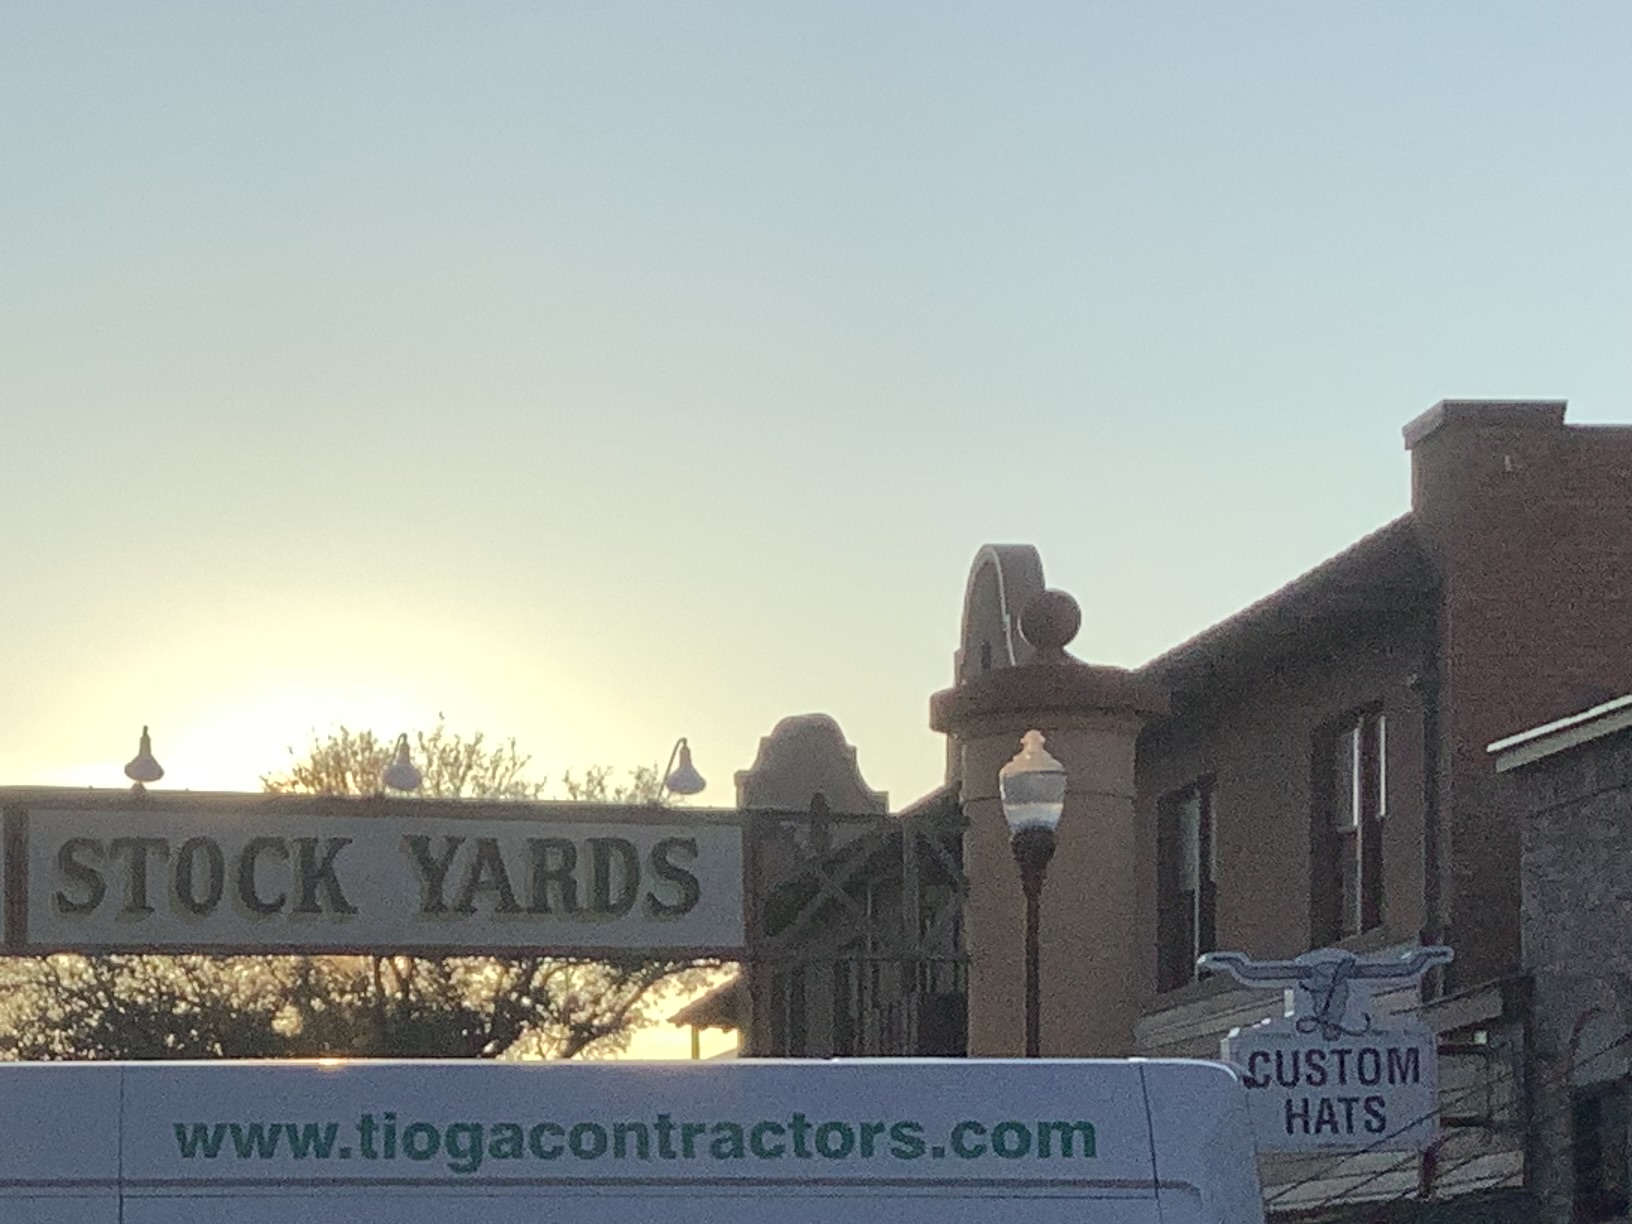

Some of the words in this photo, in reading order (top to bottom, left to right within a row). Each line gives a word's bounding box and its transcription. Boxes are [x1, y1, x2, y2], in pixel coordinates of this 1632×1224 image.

[52, 835, 359, 922] STOCK
[398, 835, 701, 922] YARDS
[1247, 1047, 1421, 1089] CUSTOM
[1285, 1095, 1387, 1135] HATS
[173, 1112, 1098, 1173] www.tiogacontractors.com
